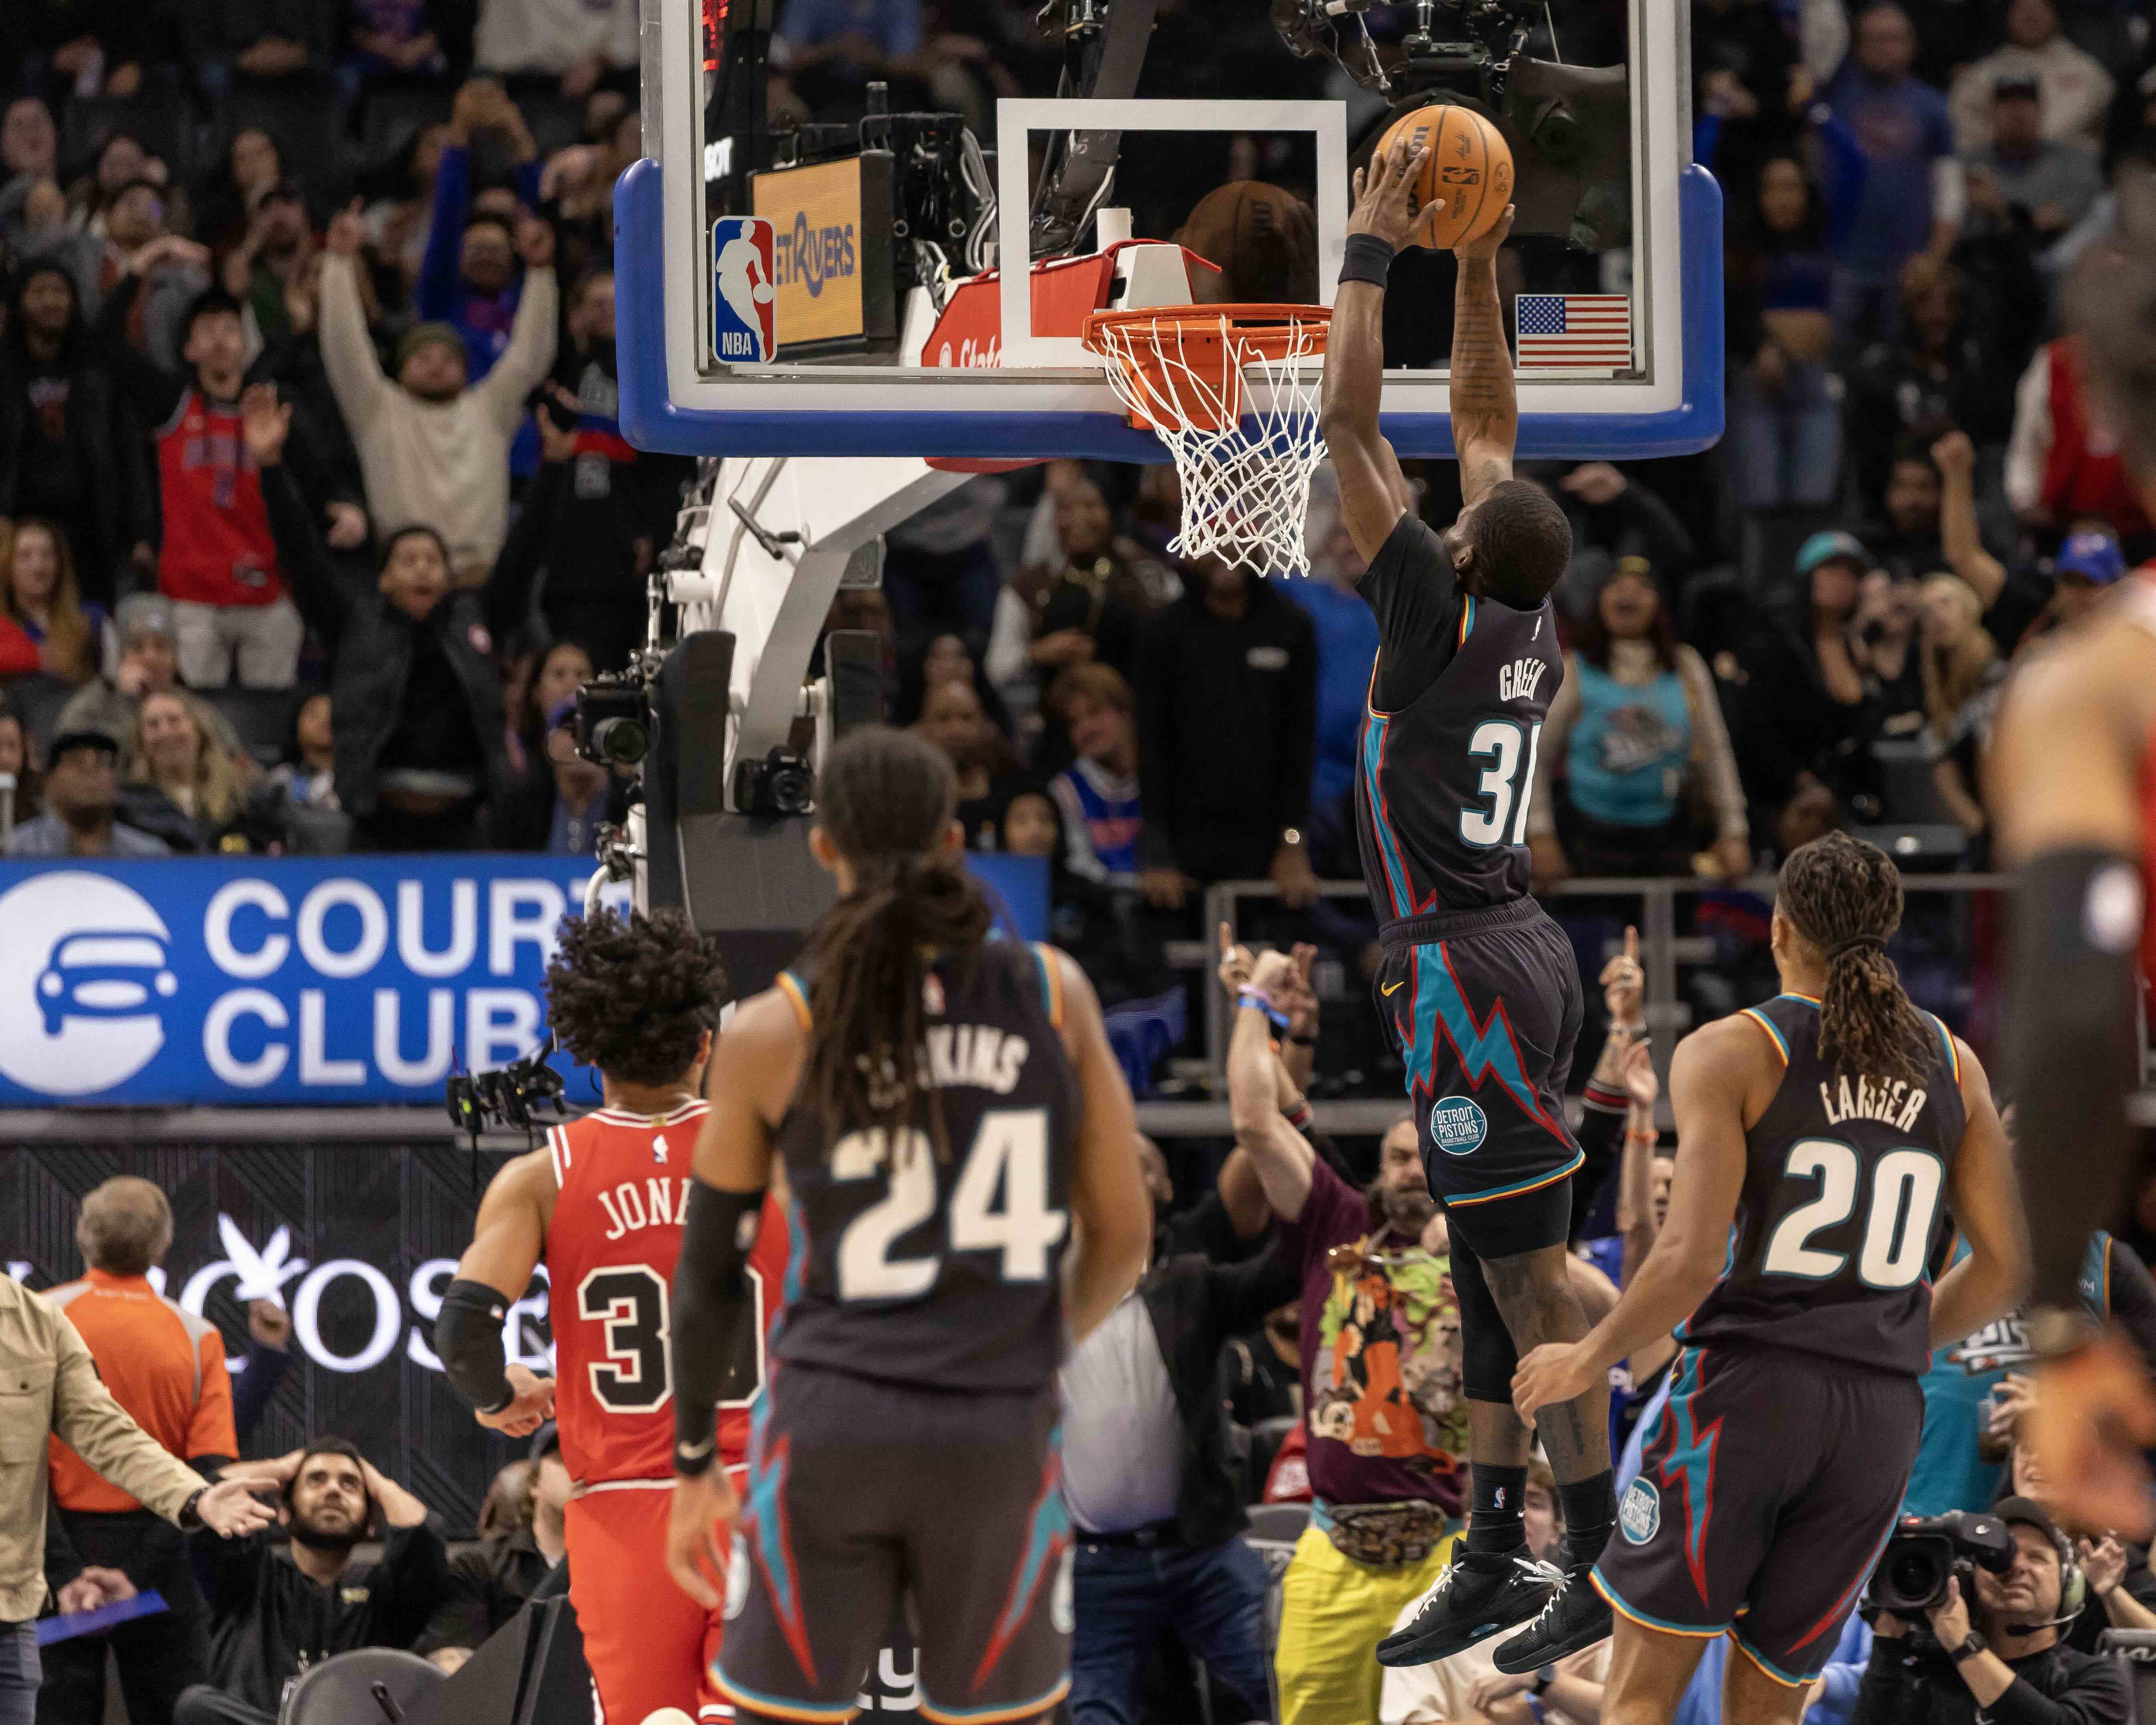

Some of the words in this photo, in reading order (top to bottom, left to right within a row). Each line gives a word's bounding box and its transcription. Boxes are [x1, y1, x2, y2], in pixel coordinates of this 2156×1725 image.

[777, 211, 854, 298] TRIVERS
[722, 332, 753, 355] NBA
[1500, 658, 1547, 701] GREEN
[1459, 719, 1543, 848] 31
[202, 988, 541, 1088] CLUB
[1436, 1106, 1473, 1124] DETROIT
[1439, 1120, 1479, 1139] PISTONS
[1819, 1074, 1927, 1133] LANIER
[1441, 1136, 1468, 1144] BASKETBALL
[597, 1176, 692, 1240] JON
[830, 1108, 1070, 1302] 24
[1762, 1136, 1945, 1290] 20
